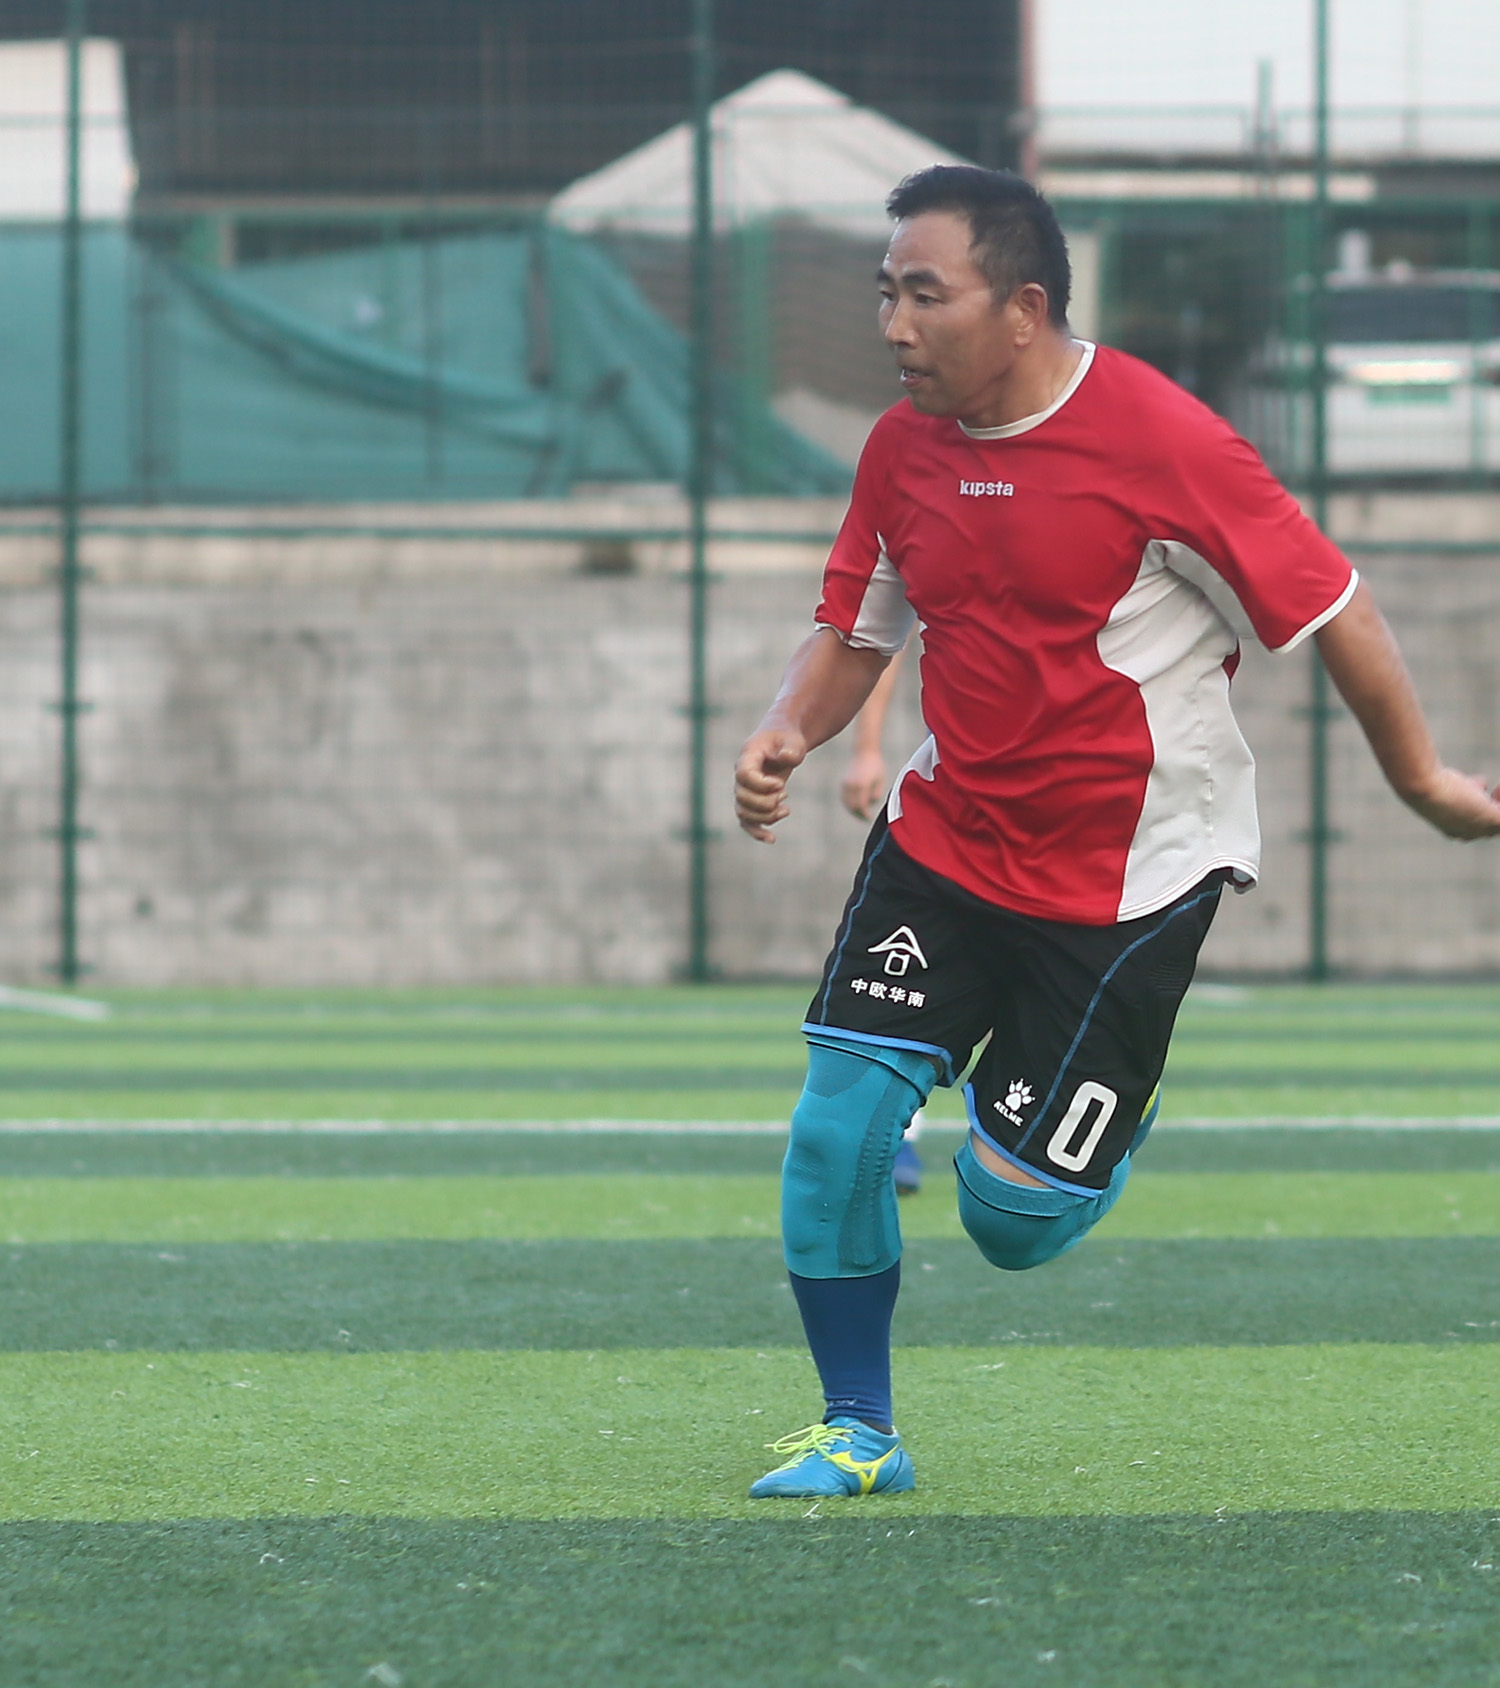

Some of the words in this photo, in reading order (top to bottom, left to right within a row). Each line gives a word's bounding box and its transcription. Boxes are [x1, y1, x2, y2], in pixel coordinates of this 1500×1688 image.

[850, 978, 926, 1008] 中欧华南
[993, 1100, 1024, 1127] KELME
[1047, 1080, 1118, 1172] 0
